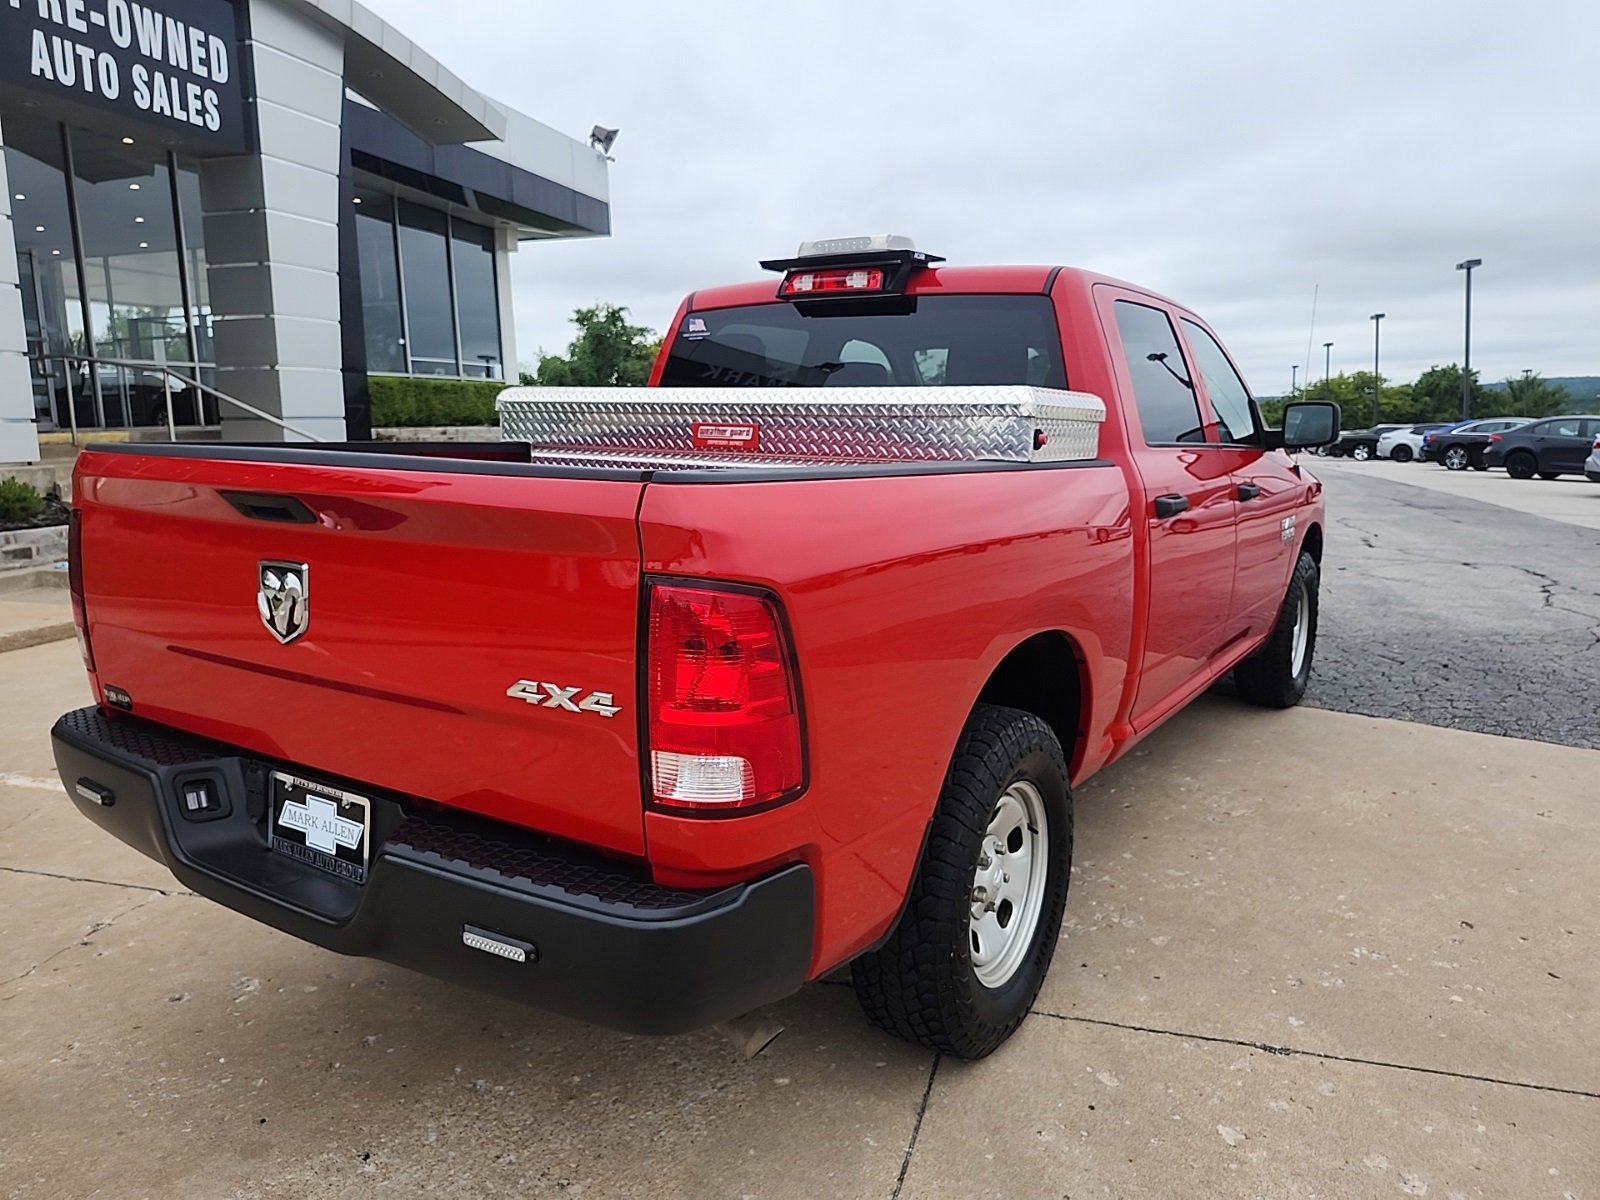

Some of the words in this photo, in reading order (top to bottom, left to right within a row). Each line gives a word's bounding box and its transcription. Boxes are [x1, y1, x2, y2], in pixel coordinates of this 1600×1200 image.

[9, 0, 229, 84] E-OWNED
[31, 29, 120, 100] AUTO
[132, 64, 221, 132] SALES
[507, 679, 622, 717] 4X4
[287, 808, 319, 830] MARK
[321, 819, 355, 841] ALLEN
[273, 837, 293, 855] MARK
[293, 845, 315, 864] ALLEN
[315, 856, 335, 870] AUTO
[336, 860, 362, 881] GROUP
